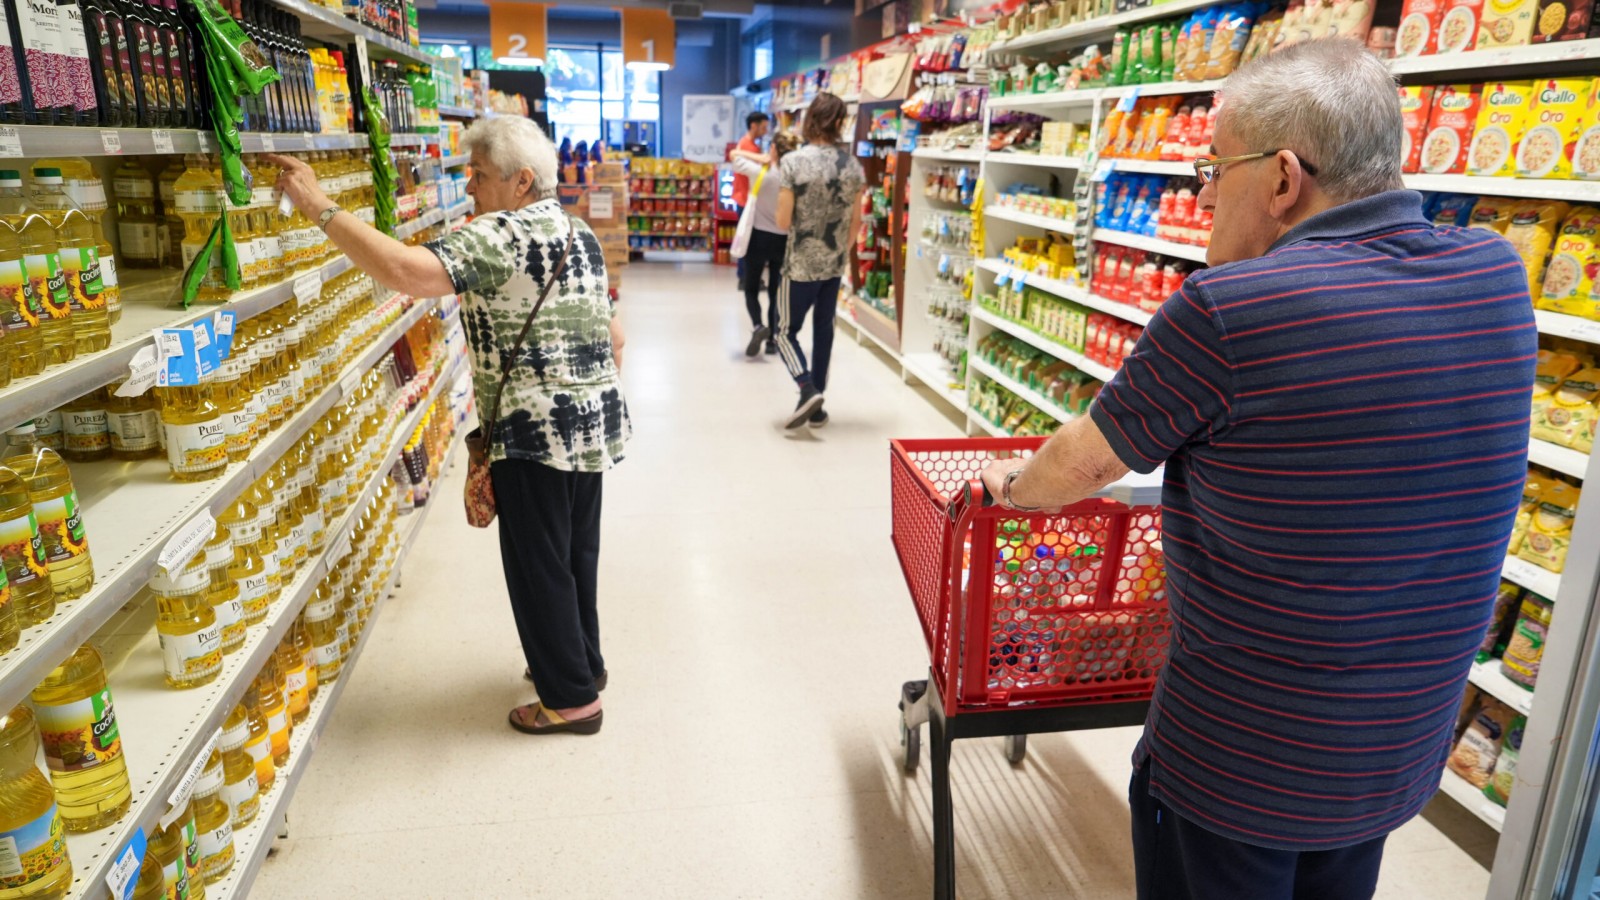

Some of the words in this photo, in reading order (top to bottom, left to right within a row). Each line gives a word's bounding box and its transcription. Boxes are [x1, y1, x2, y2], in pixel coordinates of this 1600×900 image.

[508, 34, 528, 57] 2
[641, 40, 654, 61] 1
[1441, 96, 1472, 108] Gallo
[1490, 92, 1522, 105] Gallo
[1540, 90, 1576, 103] Gallo
[1402, 98, 1421, 108] allo
[1490, 112, 1512, 123] Oro
[1540, 110, 1564, 122] Oro
[1560, 240, 1585, 251] Oro
[73, 412, 107, 424] PUREZA
